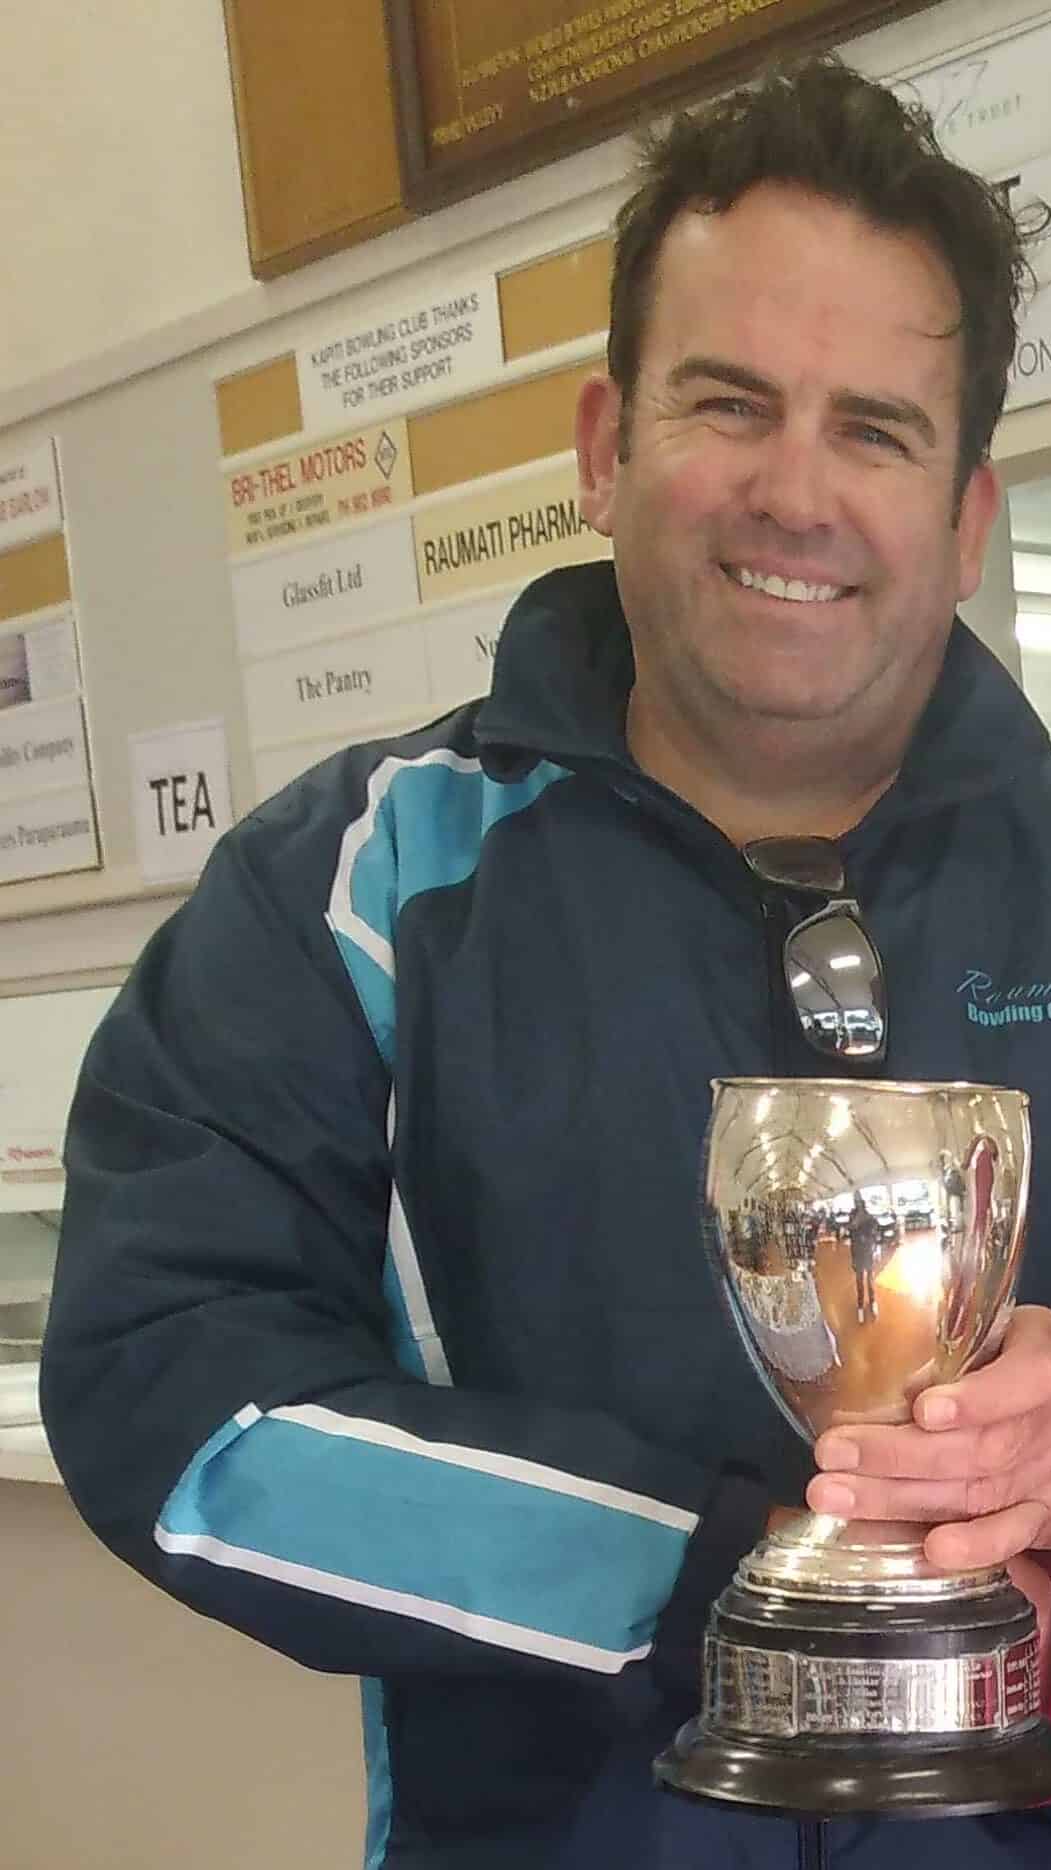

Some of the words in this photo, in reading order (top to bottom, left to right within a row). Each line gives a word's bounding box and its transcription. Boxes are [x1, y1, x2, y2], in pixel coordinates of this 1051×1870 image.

[311, 342, 345, 368] KAPITI
[346, 323, 396, 356] BOWLING
[398, 312, 428, 338] CLUB
[431, 293, 479, 325] THANKS
[322, 369, 342, 389] THE
[344, 346, 408, 382] FOLLOWING
[410, 323, 473, 360] SPONSORS
[343, 386, 365, 408] FOR
[401, 356, 453, 390] SUPPORT
[231, 464, 296, 508] BRI-THEL
[300, 438, 367, 482] MOTORS
[423, 520, 504, 577] RAUMATI
[282, 570, 331, 608] Glassfit
[336, 563, 364, 593] Ltd
[296, 675, 323, 703] The
[325, 666, 373, 697] Pantry
[149, 771, 216, 836] TEA
[968, 1002, 1043, 1027] Bowling
